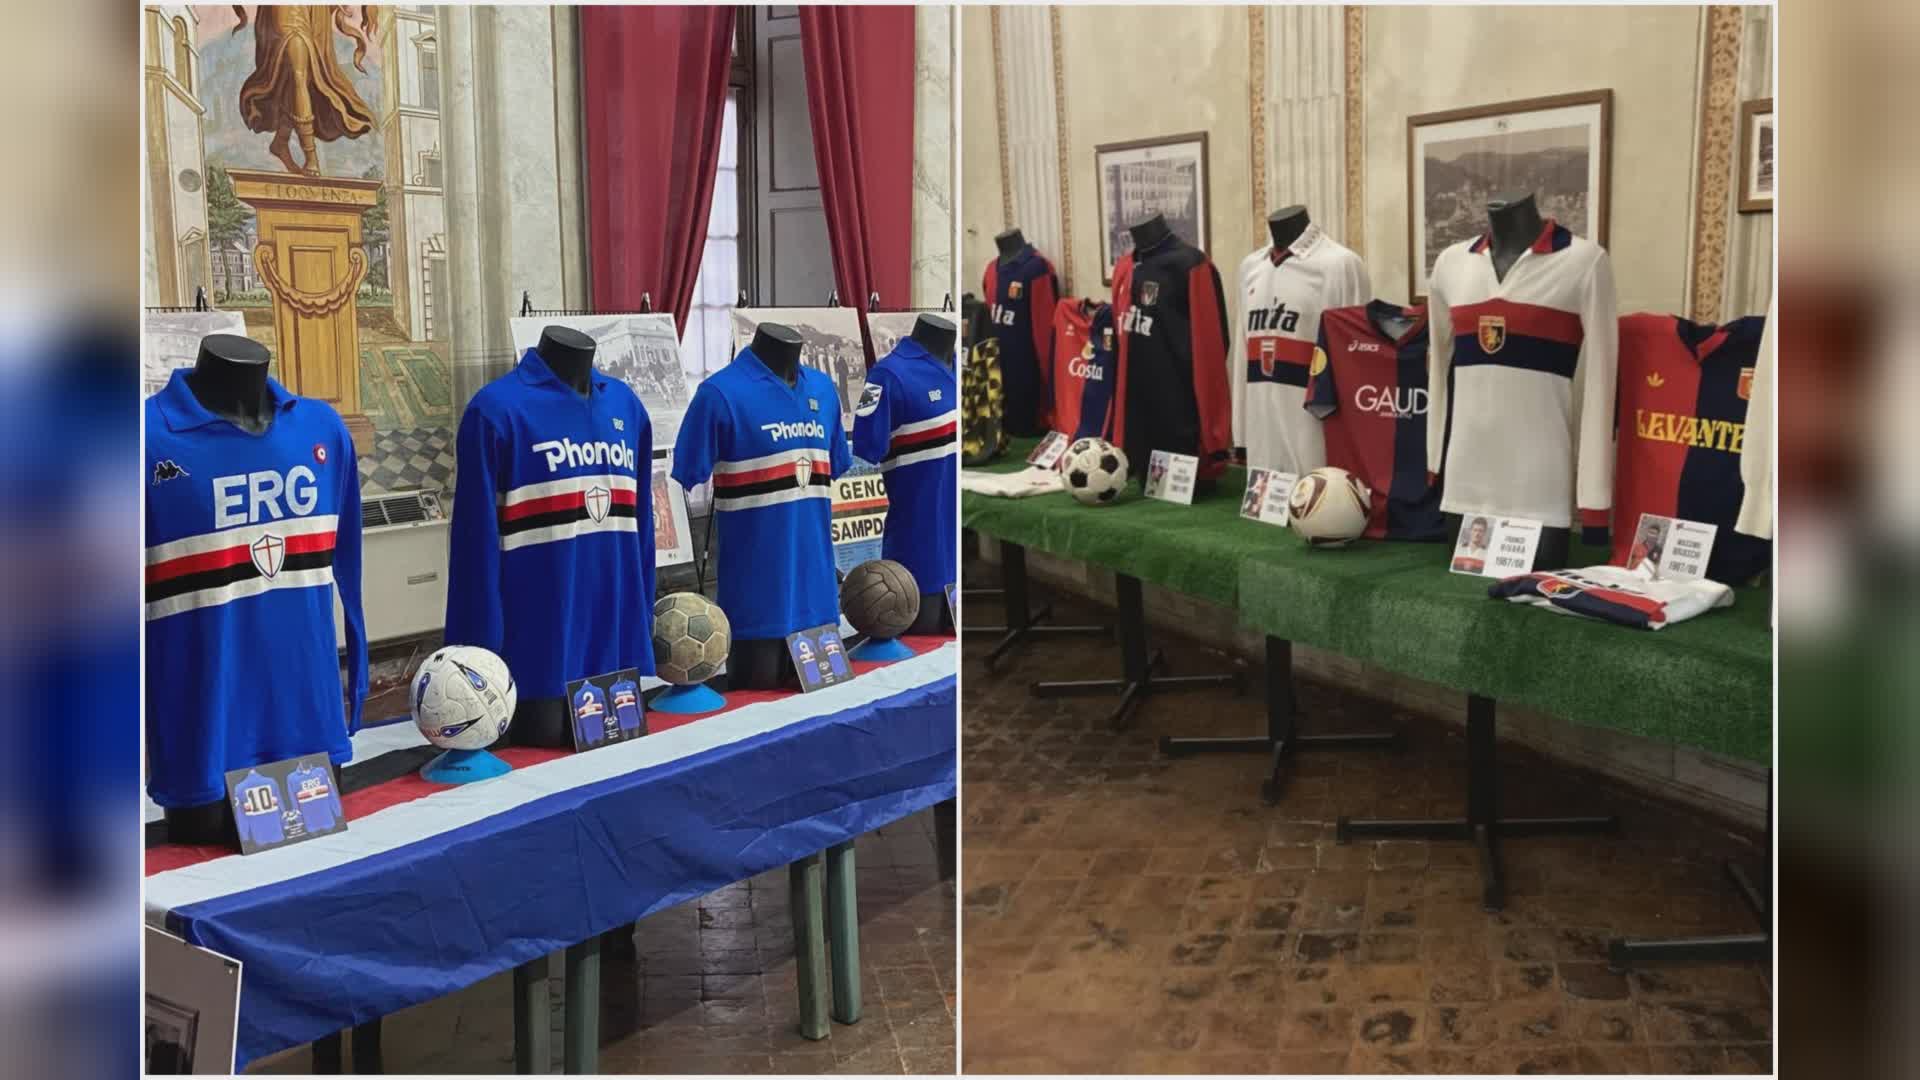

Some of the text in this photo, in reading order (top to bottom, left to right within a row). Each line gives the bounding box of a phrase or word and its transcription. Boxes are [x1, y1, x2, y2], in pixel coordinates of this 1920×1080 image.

[1068, 357, 1104, 381] Costa
[1355, 384, 1430, 415] GAUD
[761, 419, 825, 442] Phonola
[532, 437, 634, 473] Phonola
[212, 465, 318, 529] ERG
[248, 787, 273, 812] 10
